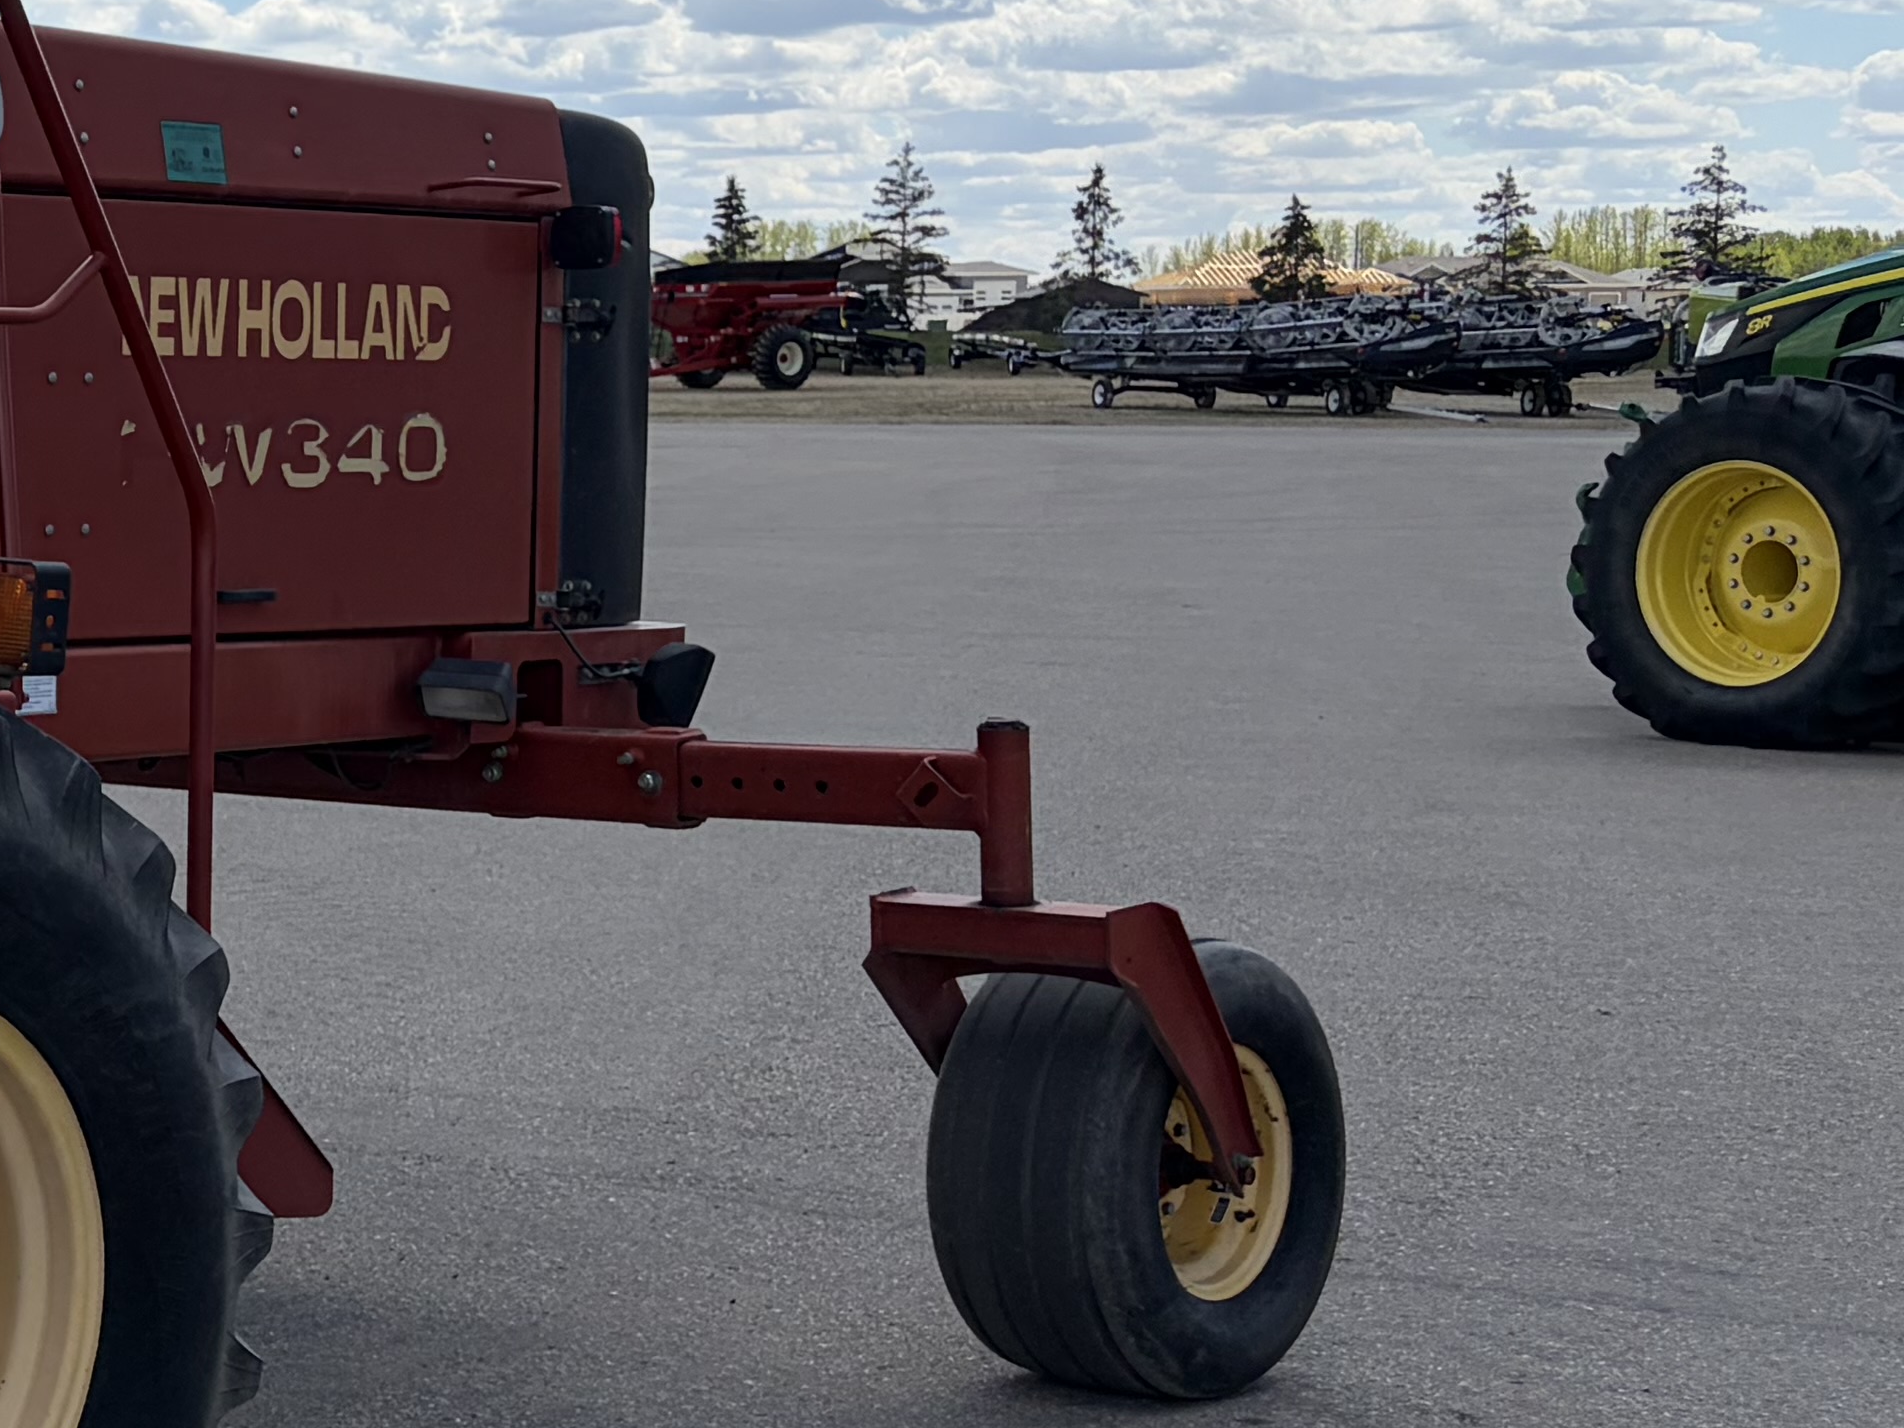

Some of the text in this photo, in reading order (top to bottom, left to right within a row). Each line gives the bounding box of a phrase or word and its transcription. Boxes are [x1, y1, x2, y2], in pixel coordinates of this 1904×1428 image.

[237, 278, 452, 361] HOLLAND
[1746, 314, 1774, 335] 8R
[120, 412, 448, 489] W340
